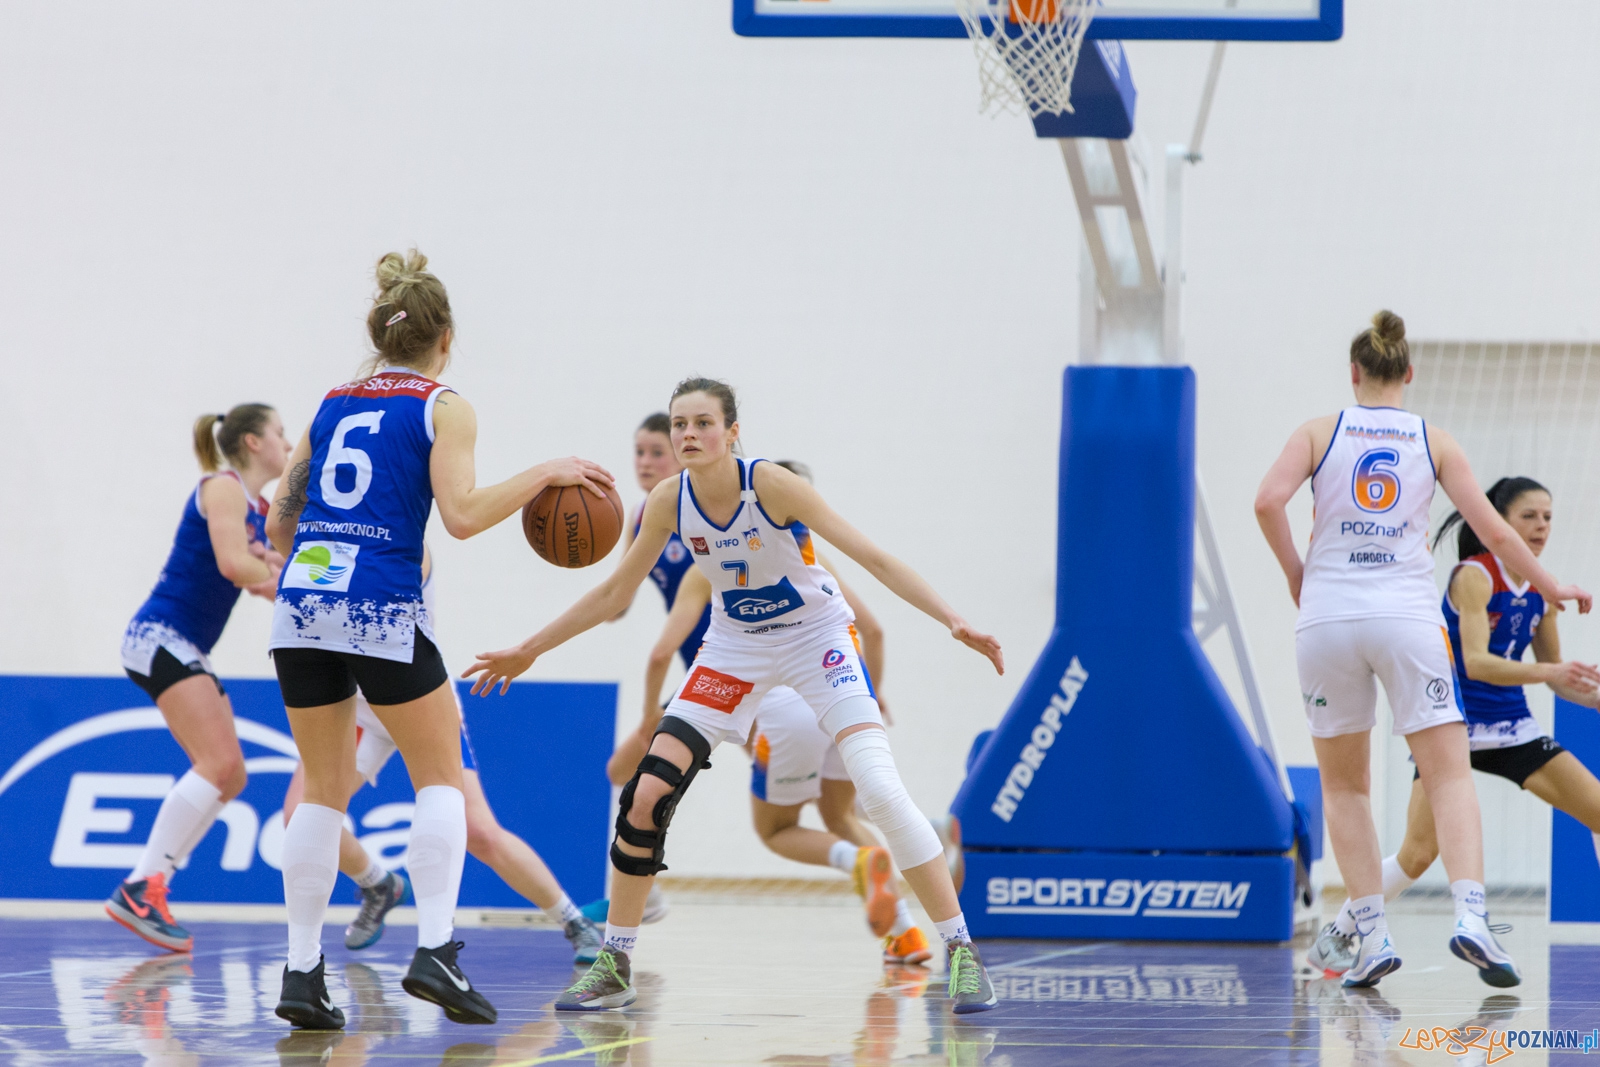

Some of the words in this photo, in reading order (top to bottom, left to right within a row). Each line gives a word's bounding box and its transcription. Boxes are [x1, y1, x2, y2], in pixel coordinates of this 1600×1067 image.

[320, 409, 386, 510] 6
[1352, 447, 1401, 514] 6
[721, 560, 749, 587] 7
[1348, 552, 1397, 563] AGROBEX
[739, 599, 790, 615] Enea
[991, 656, 1089, 823] HYDROPLAY
